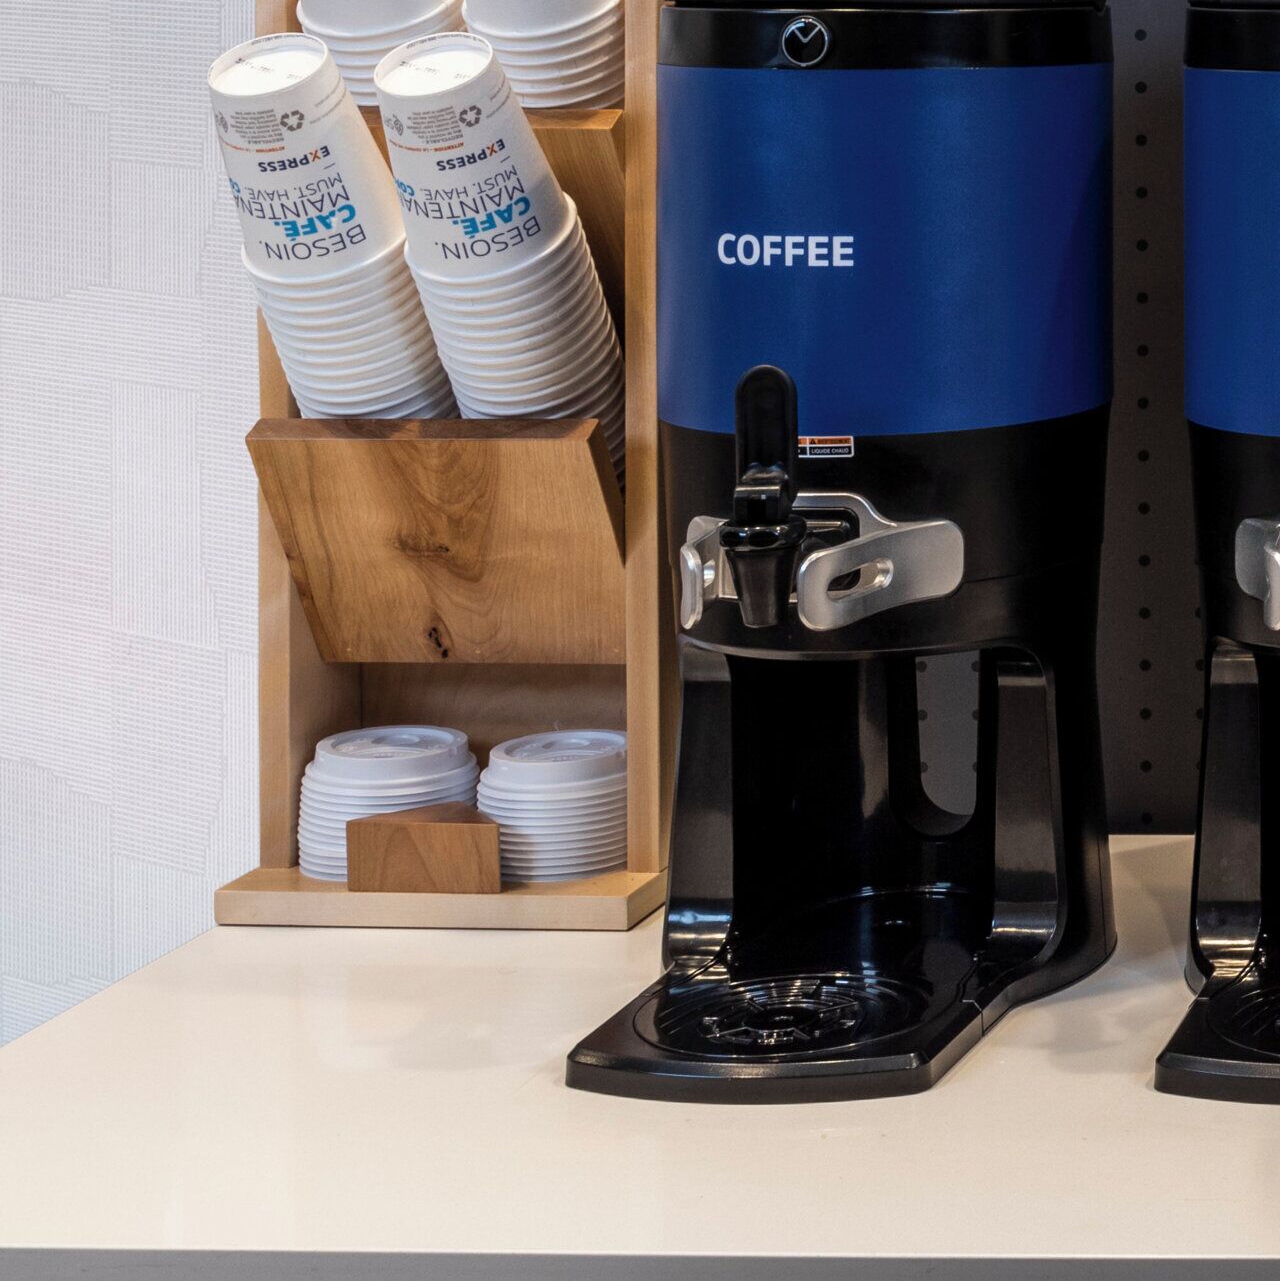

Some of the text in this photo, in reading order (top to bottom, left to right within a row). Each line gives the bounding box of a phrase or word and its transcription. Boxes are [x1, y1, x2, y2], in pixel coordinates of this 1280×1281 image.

[258, 146, 331, 172] EXPRESS
[436, 139, 506, 171] EXPRESS
[244, 172, 343, 201] MUST. HAVE.
[420, 186, 468, 201] HAVE.
[473, 165, 518, 194] MUST.
[274, 204, 356, 242] CAFÉ.
[452, 196, 531, 239] CAFÉ.
[259, 224, 366, 260] BESOIN.
[435, 216, 541, 259] BESOIN.
[717, 233, 854, 267] COFFEE
